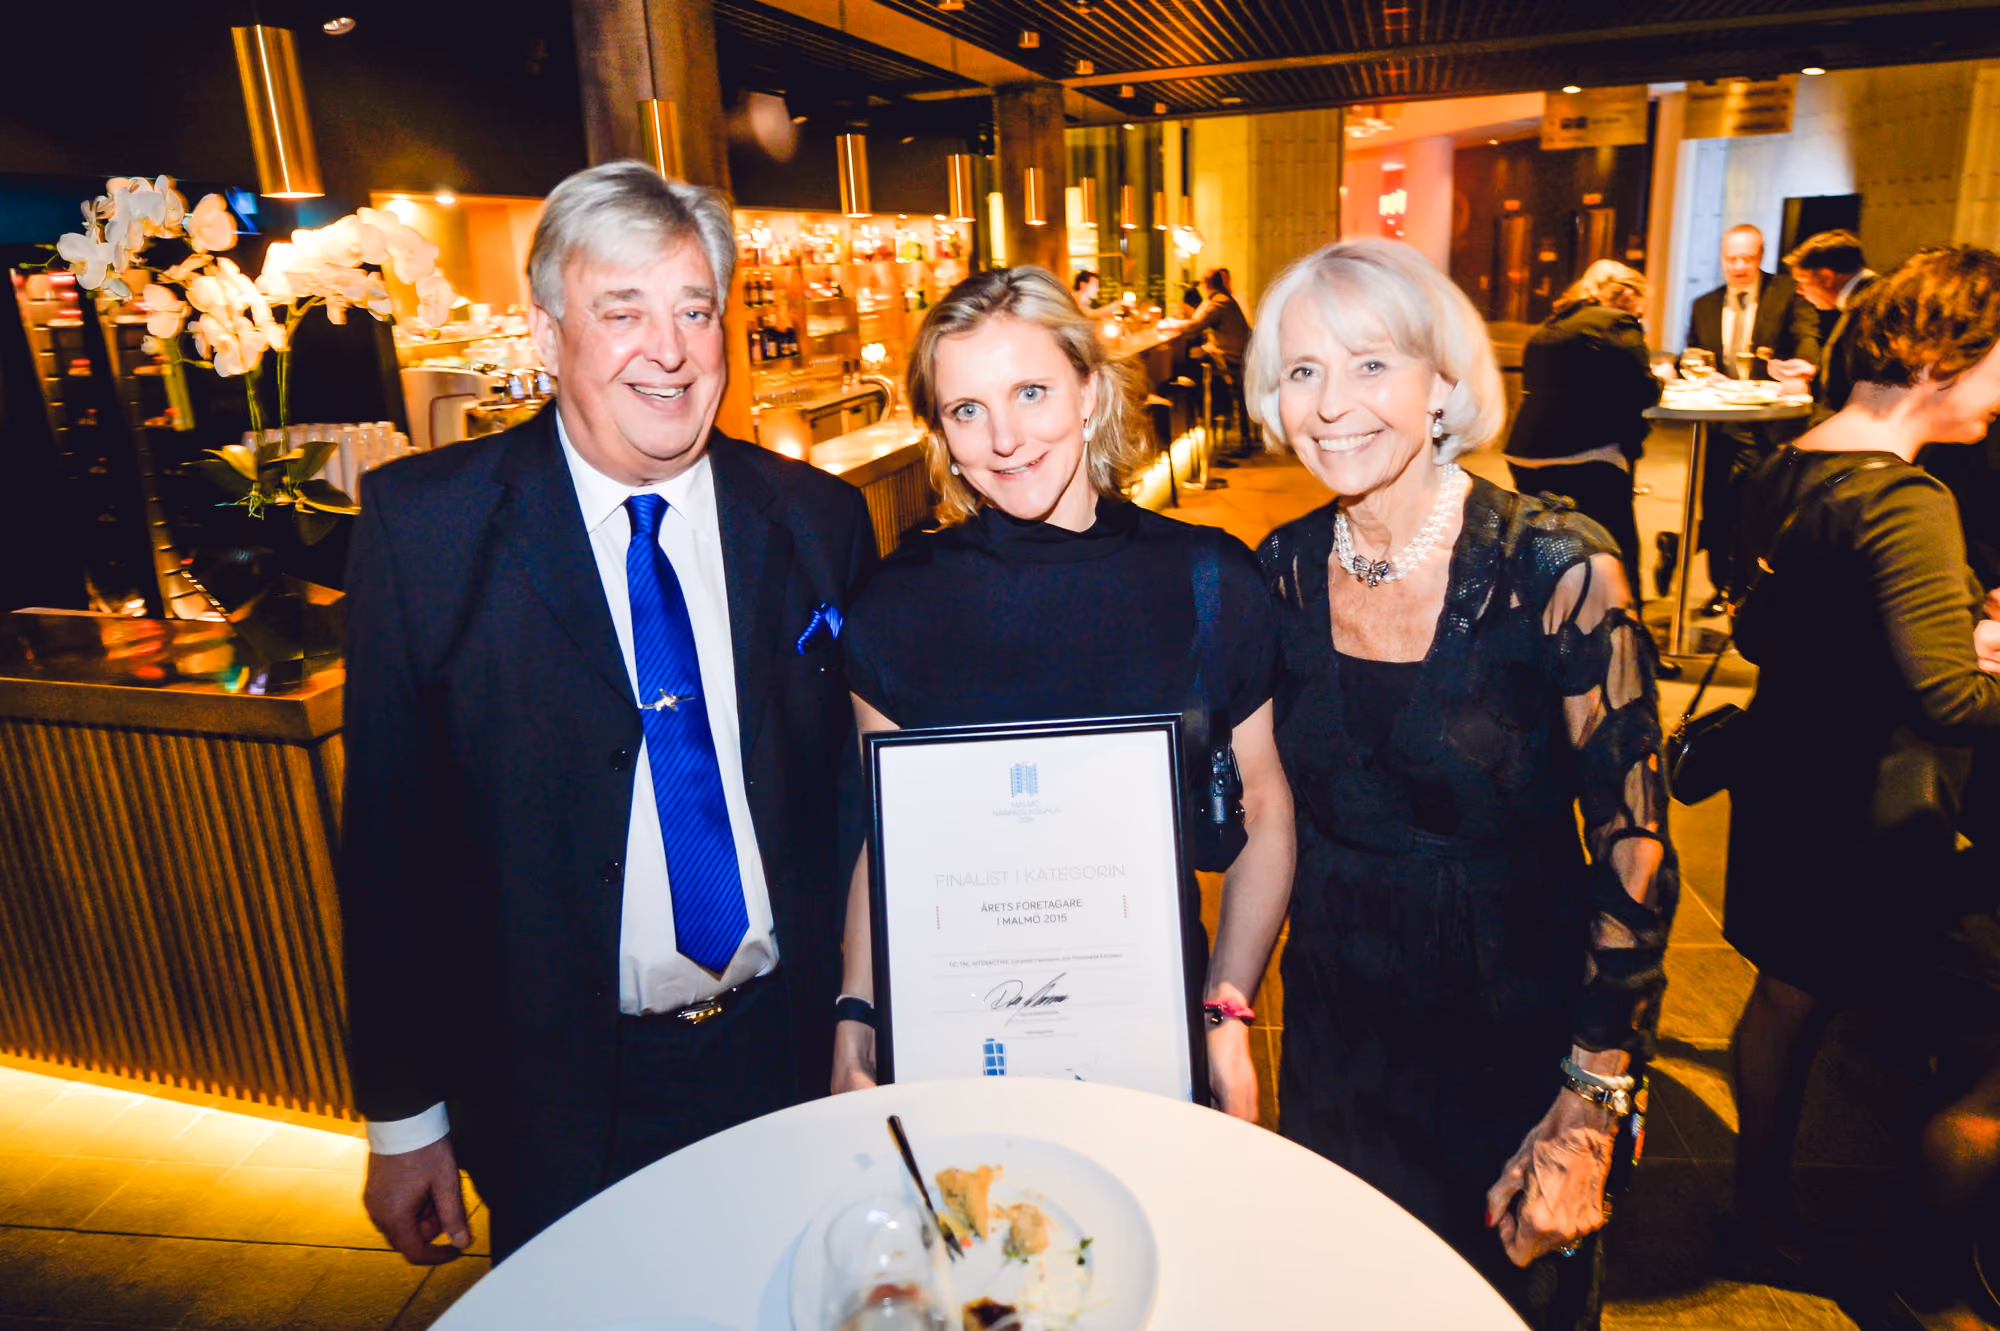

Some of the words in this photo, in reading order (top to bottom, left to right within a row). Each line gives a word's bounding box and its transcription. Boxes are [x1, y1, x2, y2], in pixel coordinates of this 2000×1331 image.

[935, 871, 1007, 888] FINALIST
[1024, 864, 1126, 882] KATEGORIN
[980, 900, 1014, 912] ÅRETS
[1002, 914, 1040, 926] MALMÖ
[1044, 913, 1068, 924] 2015
